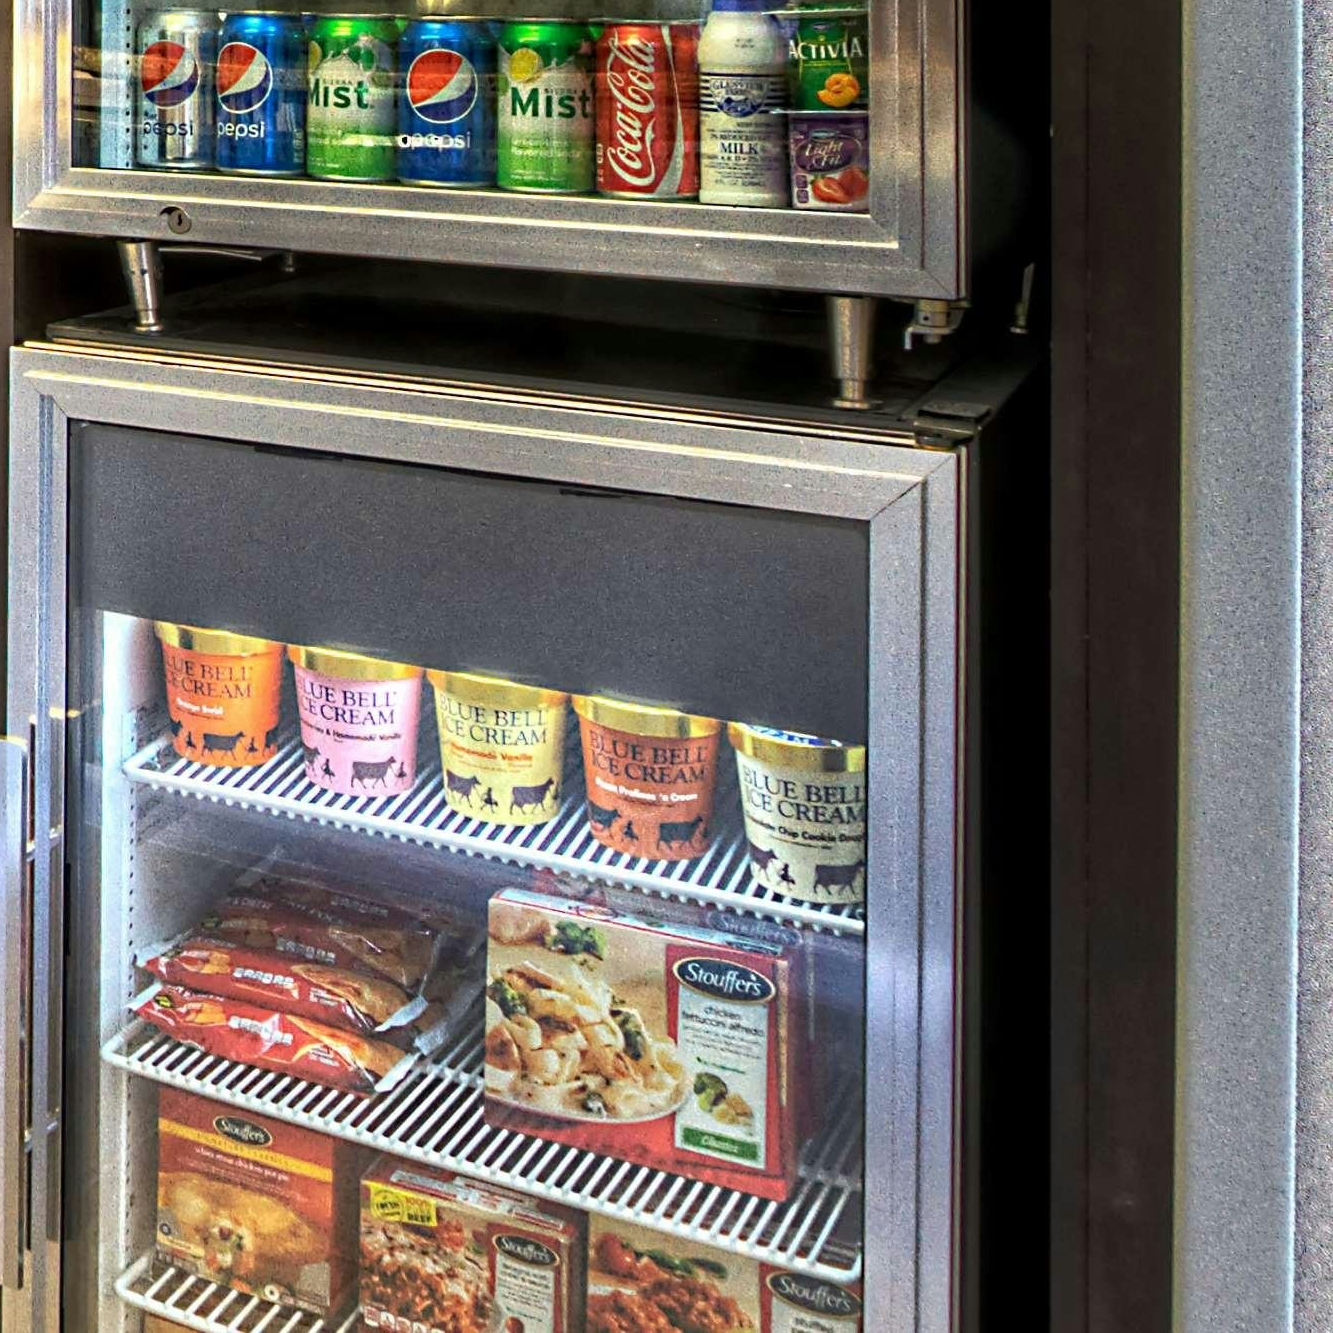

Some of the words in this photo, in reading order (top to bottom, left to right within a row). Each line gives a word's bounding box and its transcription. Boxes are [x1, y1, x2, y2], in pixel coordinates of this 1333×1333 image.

[788, 37, 863, 60] ACTIVIA
[510, 86, 591, 119] Mist
[142, 120, 194, 138] pepsi
[217, 120, 266, 140] pepsi
[719, 142, 759, 155] MILK
[200, 664, 252, 682] BELL
[181, 676, 252, 699] CREAM
[303, 680, 337, 704] LUE
[341, 689, 395, 708] BELL
[320, 703, 395, 726] CREAM
[494, 709, 546, 727] BELL
[469, 724, 548, 746] CREAM
[652, 746, 706, 765] BELL
[623, 762, 707, 784] CREAM
[742, 764, 798, 800] BLUE
[777, 800, 864, 825] CREAM
[684, 962, 763, 996] Stouffer's
